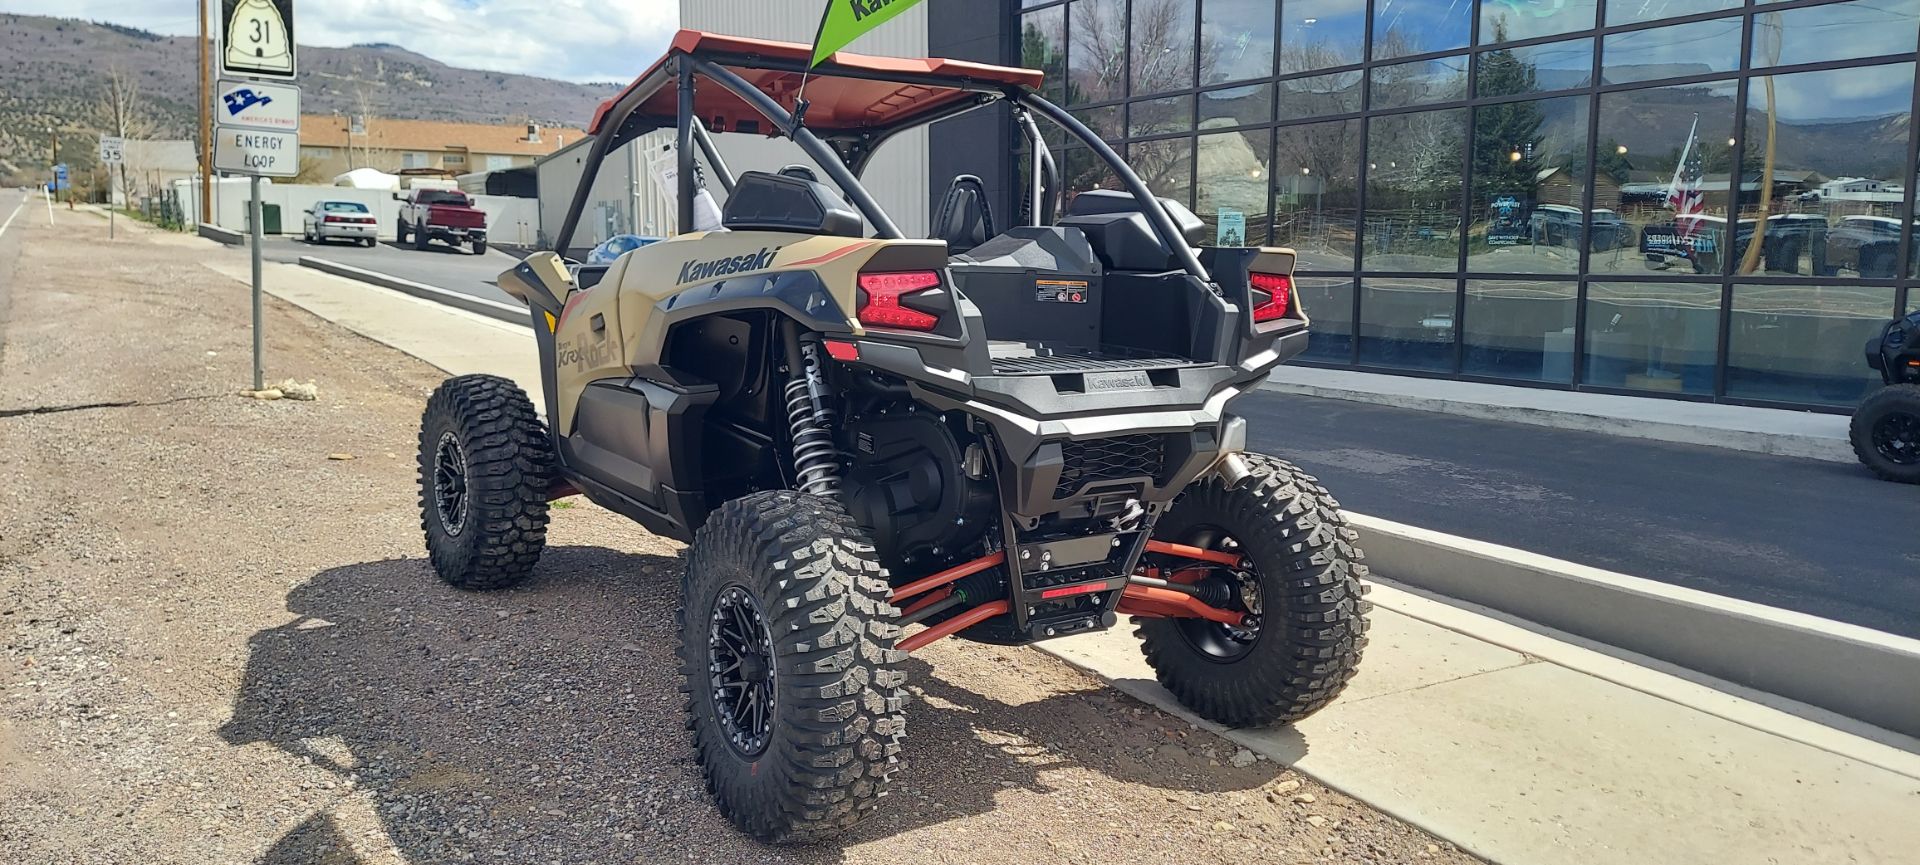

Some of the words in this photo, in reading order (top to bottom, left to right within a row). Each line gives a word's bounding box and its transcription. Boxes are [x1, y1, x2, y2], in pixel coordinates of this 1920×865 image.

[249, 18, 269, 44] 31
[235, 134, 283, 149] ENERGY
[103, 149, 121, 160] 35
[244, 154, 276, 168] LOOP
[676, 246, 782, 285] Kawasaki
[558, 349, 584, 368] KRX
[802, 343, 822, 386] FOX
[1086, 374, 1148, 390] Kawasaki
